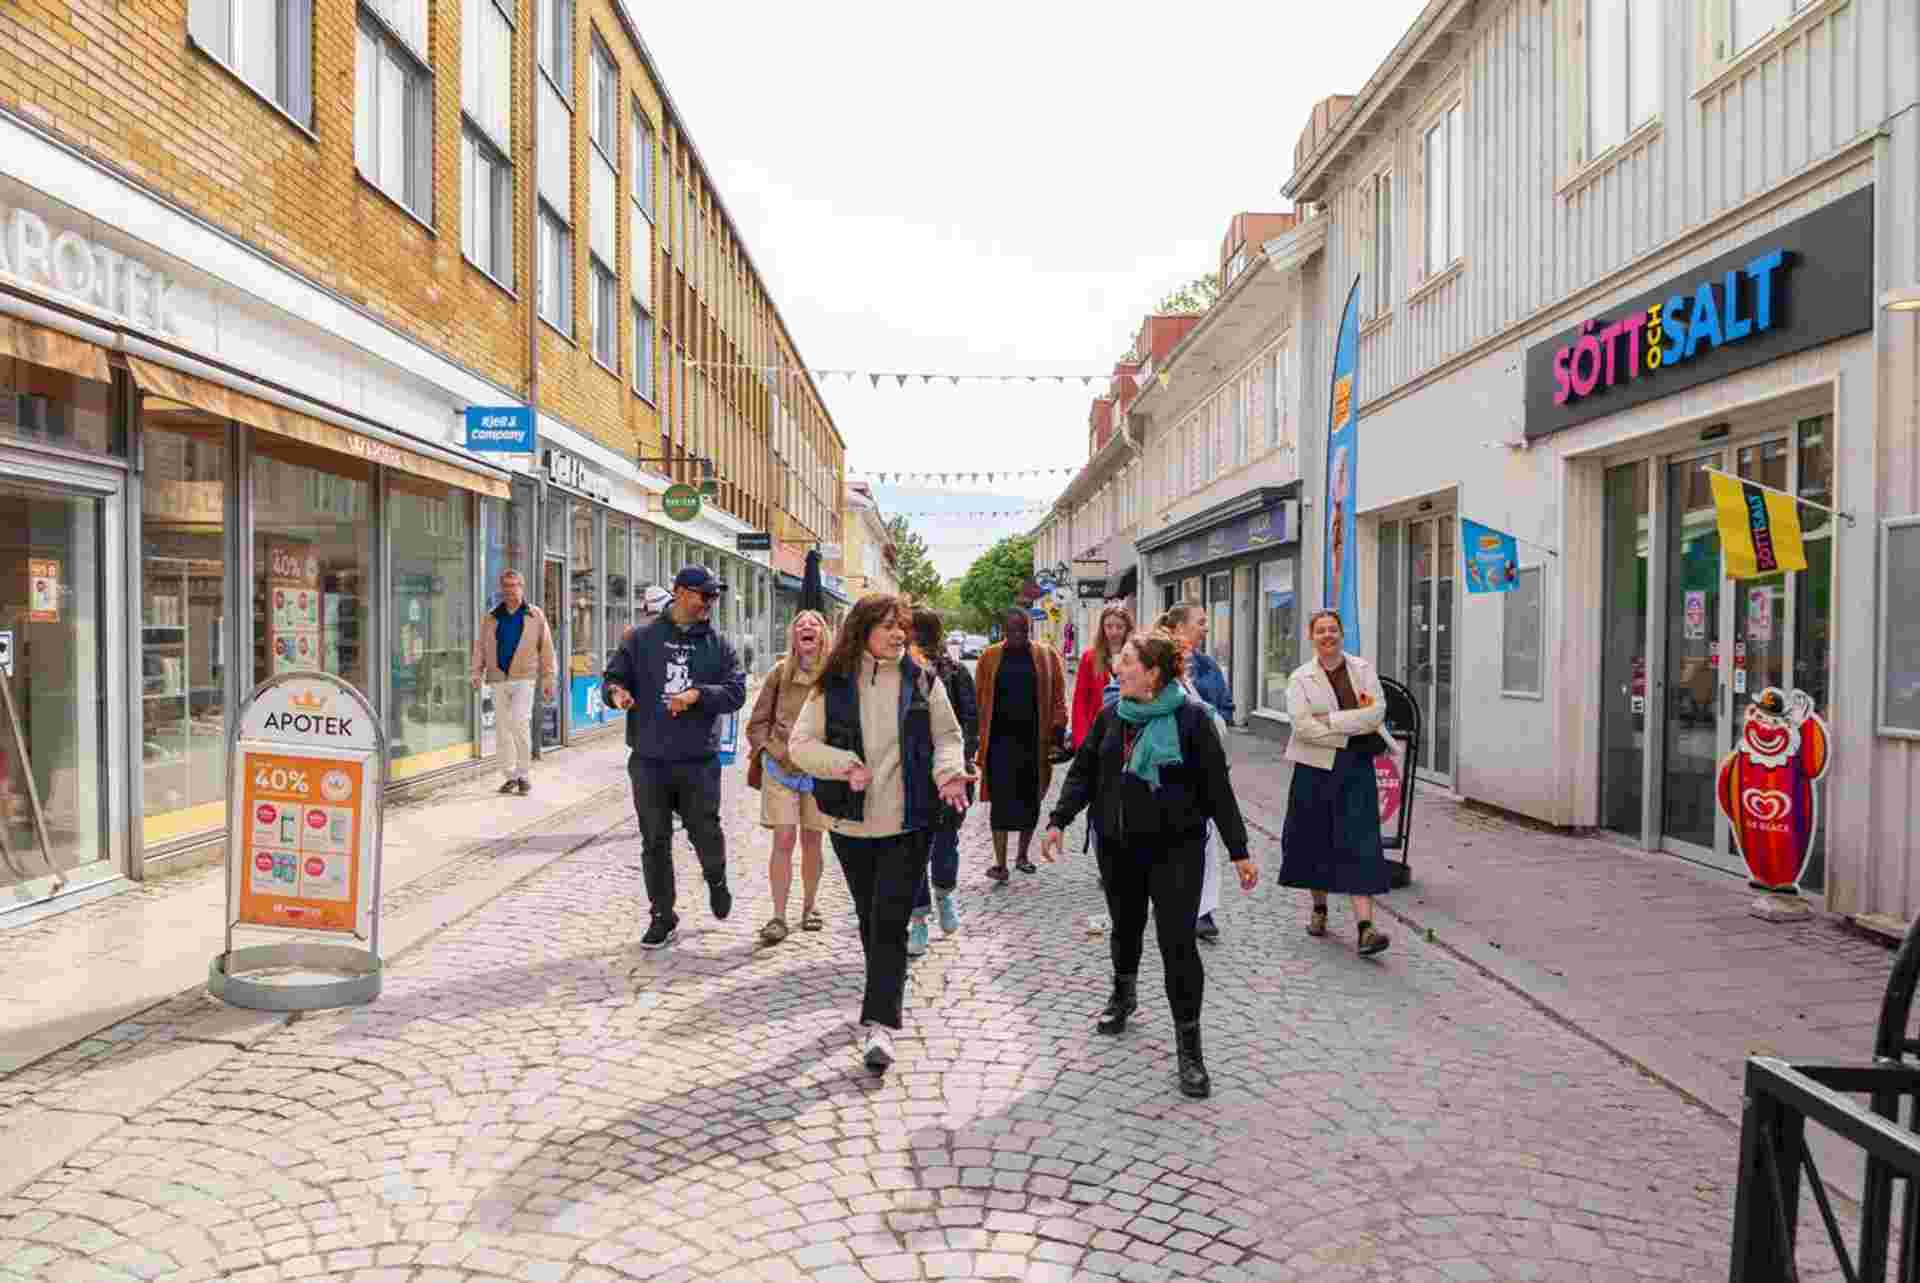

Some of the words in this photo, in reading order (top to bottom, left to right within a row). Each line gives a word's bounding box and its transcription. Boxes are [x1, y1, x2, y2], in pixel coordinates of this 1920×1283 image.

[1553, 312, 1647, 406] SÖTT
[1647, 304, 1663, 369] OCH
[1663, 248, 1788, 366] SALT
[1748, 496, 1768, 530] SALT
[264, 711, 353, 737] APOTEK
[255, 767, 310, 793] 40%
